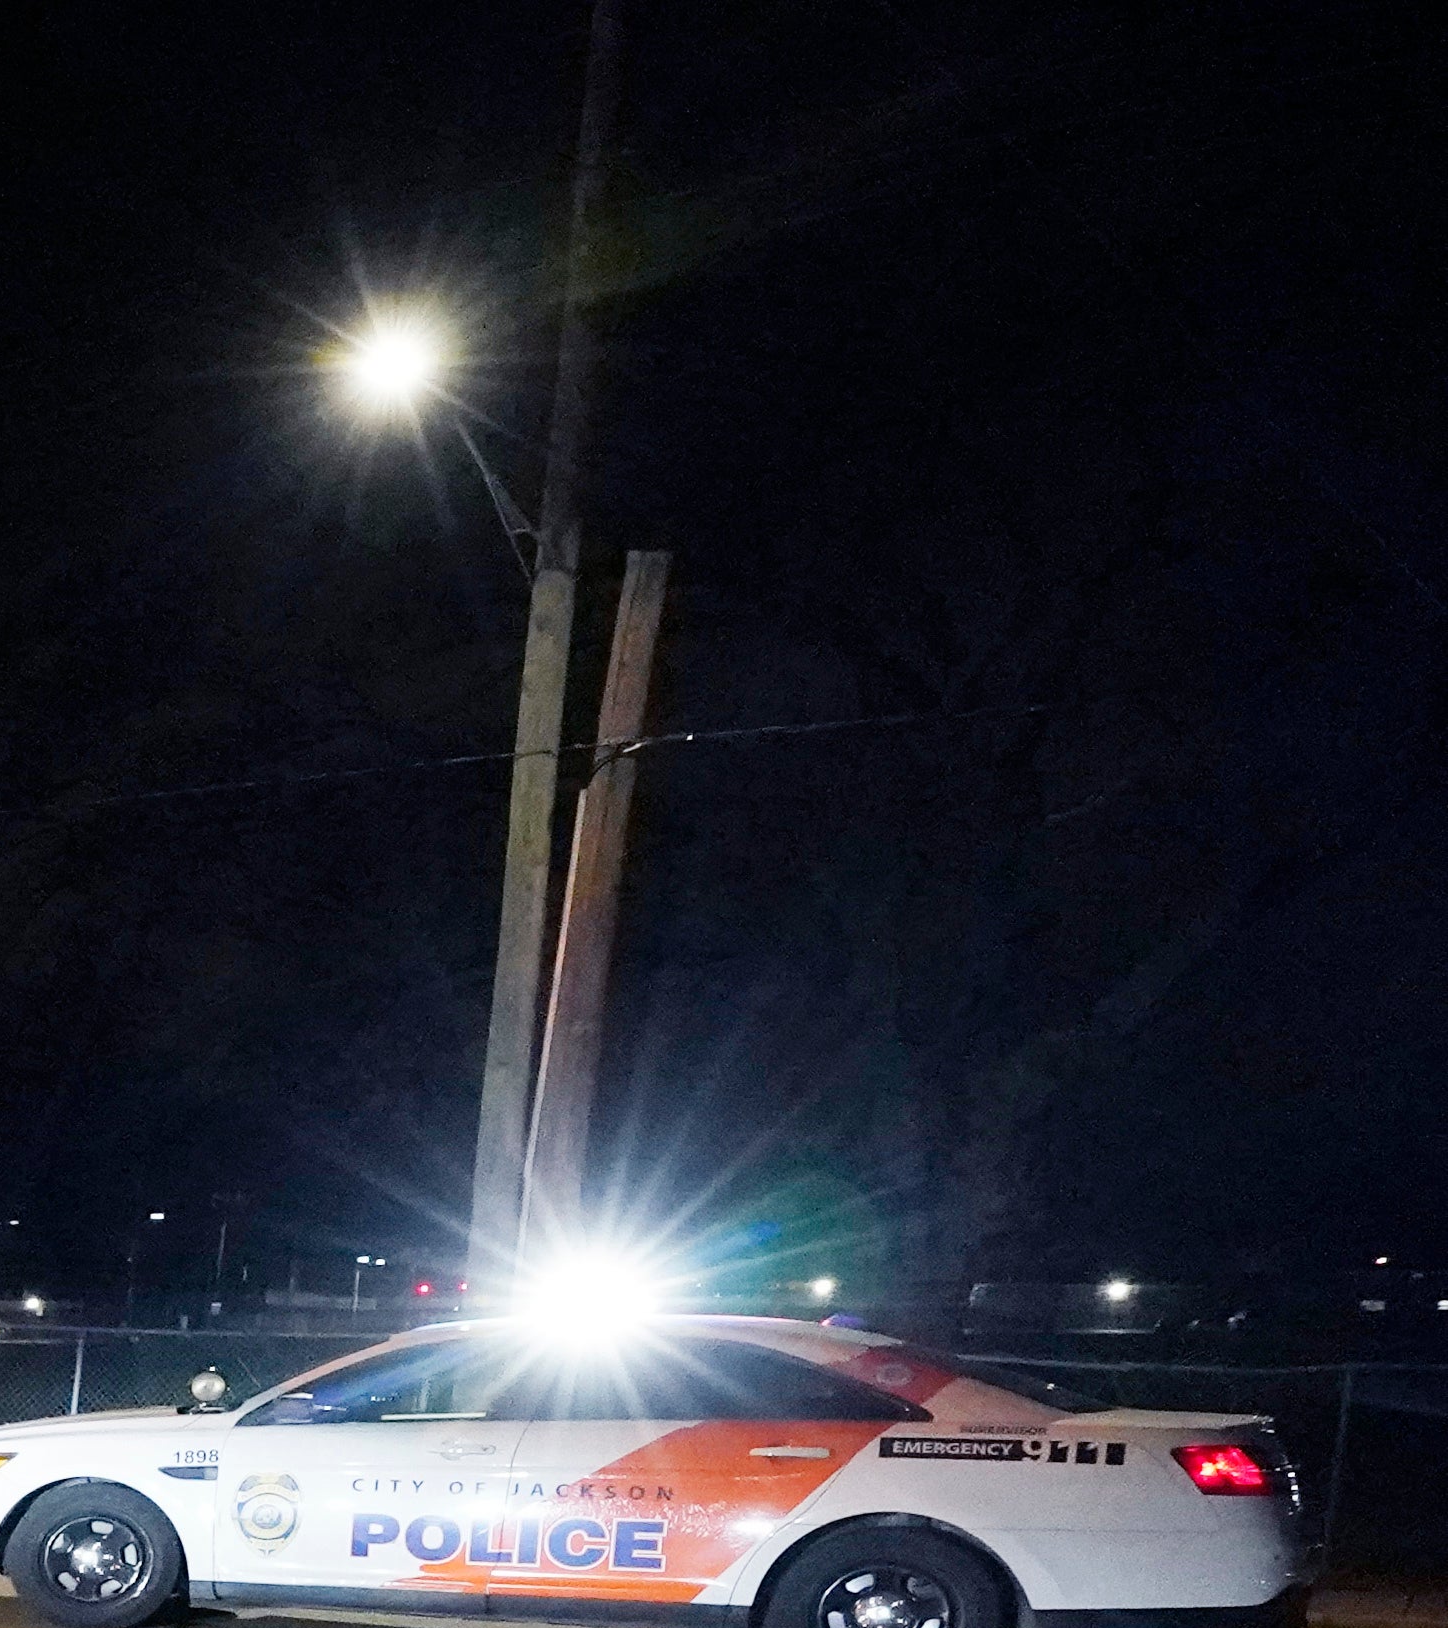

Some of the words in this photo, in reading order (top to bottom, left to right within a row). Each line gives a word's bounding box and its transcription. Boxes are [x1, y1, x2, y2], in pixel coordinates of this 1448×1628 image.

[174, 1449, 219, 1464] 1898
[892, 1440, 1014, 1456] EMERGENCY
[352, 1478, 426, 1493] CITY
[449, 1481, 486, 1496] OF
[510, 1483, 674, 1501] JACKSON
[349, 1513, 669, 1573] POLICE
